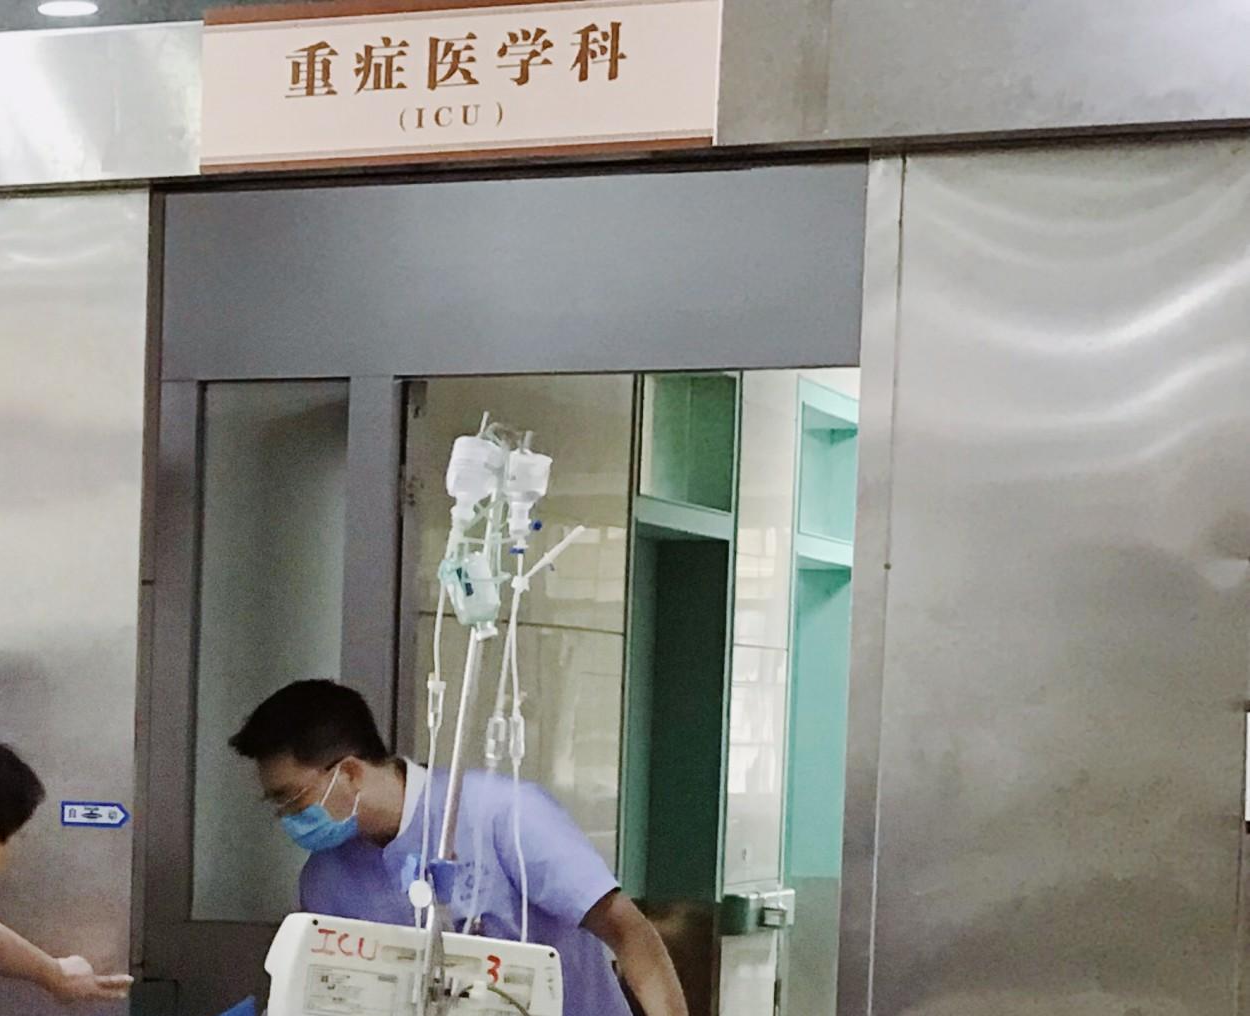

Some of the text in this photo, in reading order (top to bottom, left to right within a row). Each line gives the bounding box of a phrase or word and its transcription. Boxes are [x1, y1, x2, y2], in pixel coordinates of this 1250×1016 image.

[284, 20, 627, 99] 重症医学科
[398, 102, 504, 132] (ICU)
[311, 928, 377, 961] ICU
